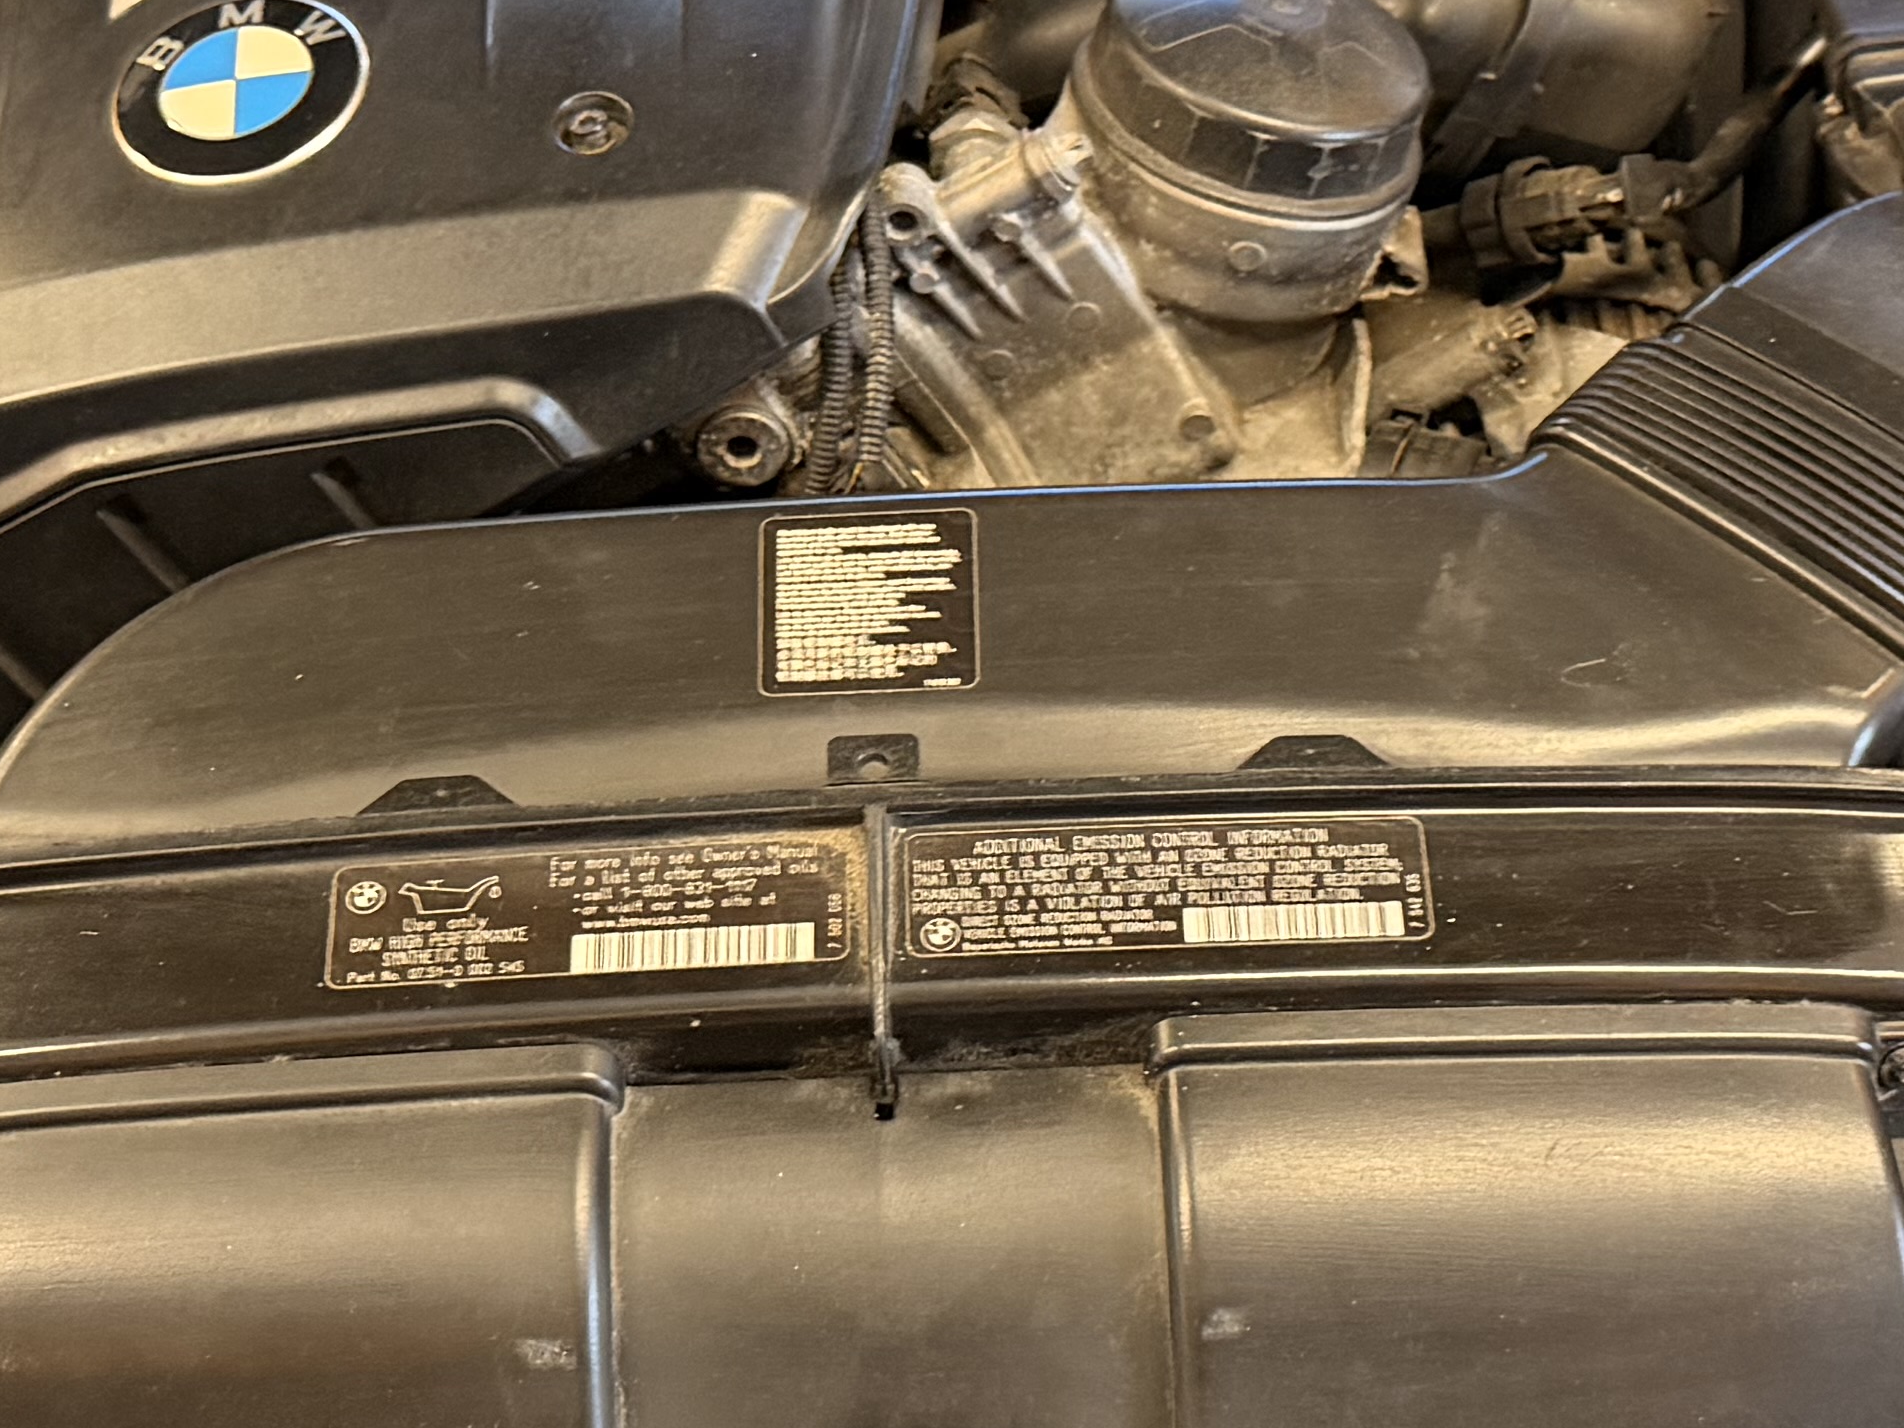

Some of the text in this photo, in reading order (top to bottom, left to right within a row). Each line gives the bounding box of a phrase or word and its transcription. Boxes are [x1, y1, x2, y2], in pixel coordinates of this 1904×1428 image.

[136, 0, 346, 71] BMW
[1072, 834, 1145, 851] EMISSION
[1151, 832, 1218, 847] CONTROL
[550, 857, 577, 871] For
[584, 858, 621, 869] more
[766, 844, 818, 858] Manual
[950, 856, 1012, 870] VEHICLE
[1040, 852, 1109, 867] EQUIPPED
[1012, 884, 1026, 896] A
[1026, 899, 1039, 910] A
[1046, 895, 1123, 910] VIOLATION
[446, 914, 489, 930] only
[349, 937, 383, 953] BMW
[464, 946, 489, 961] OIL
[346, 972, 375, 984] Part
